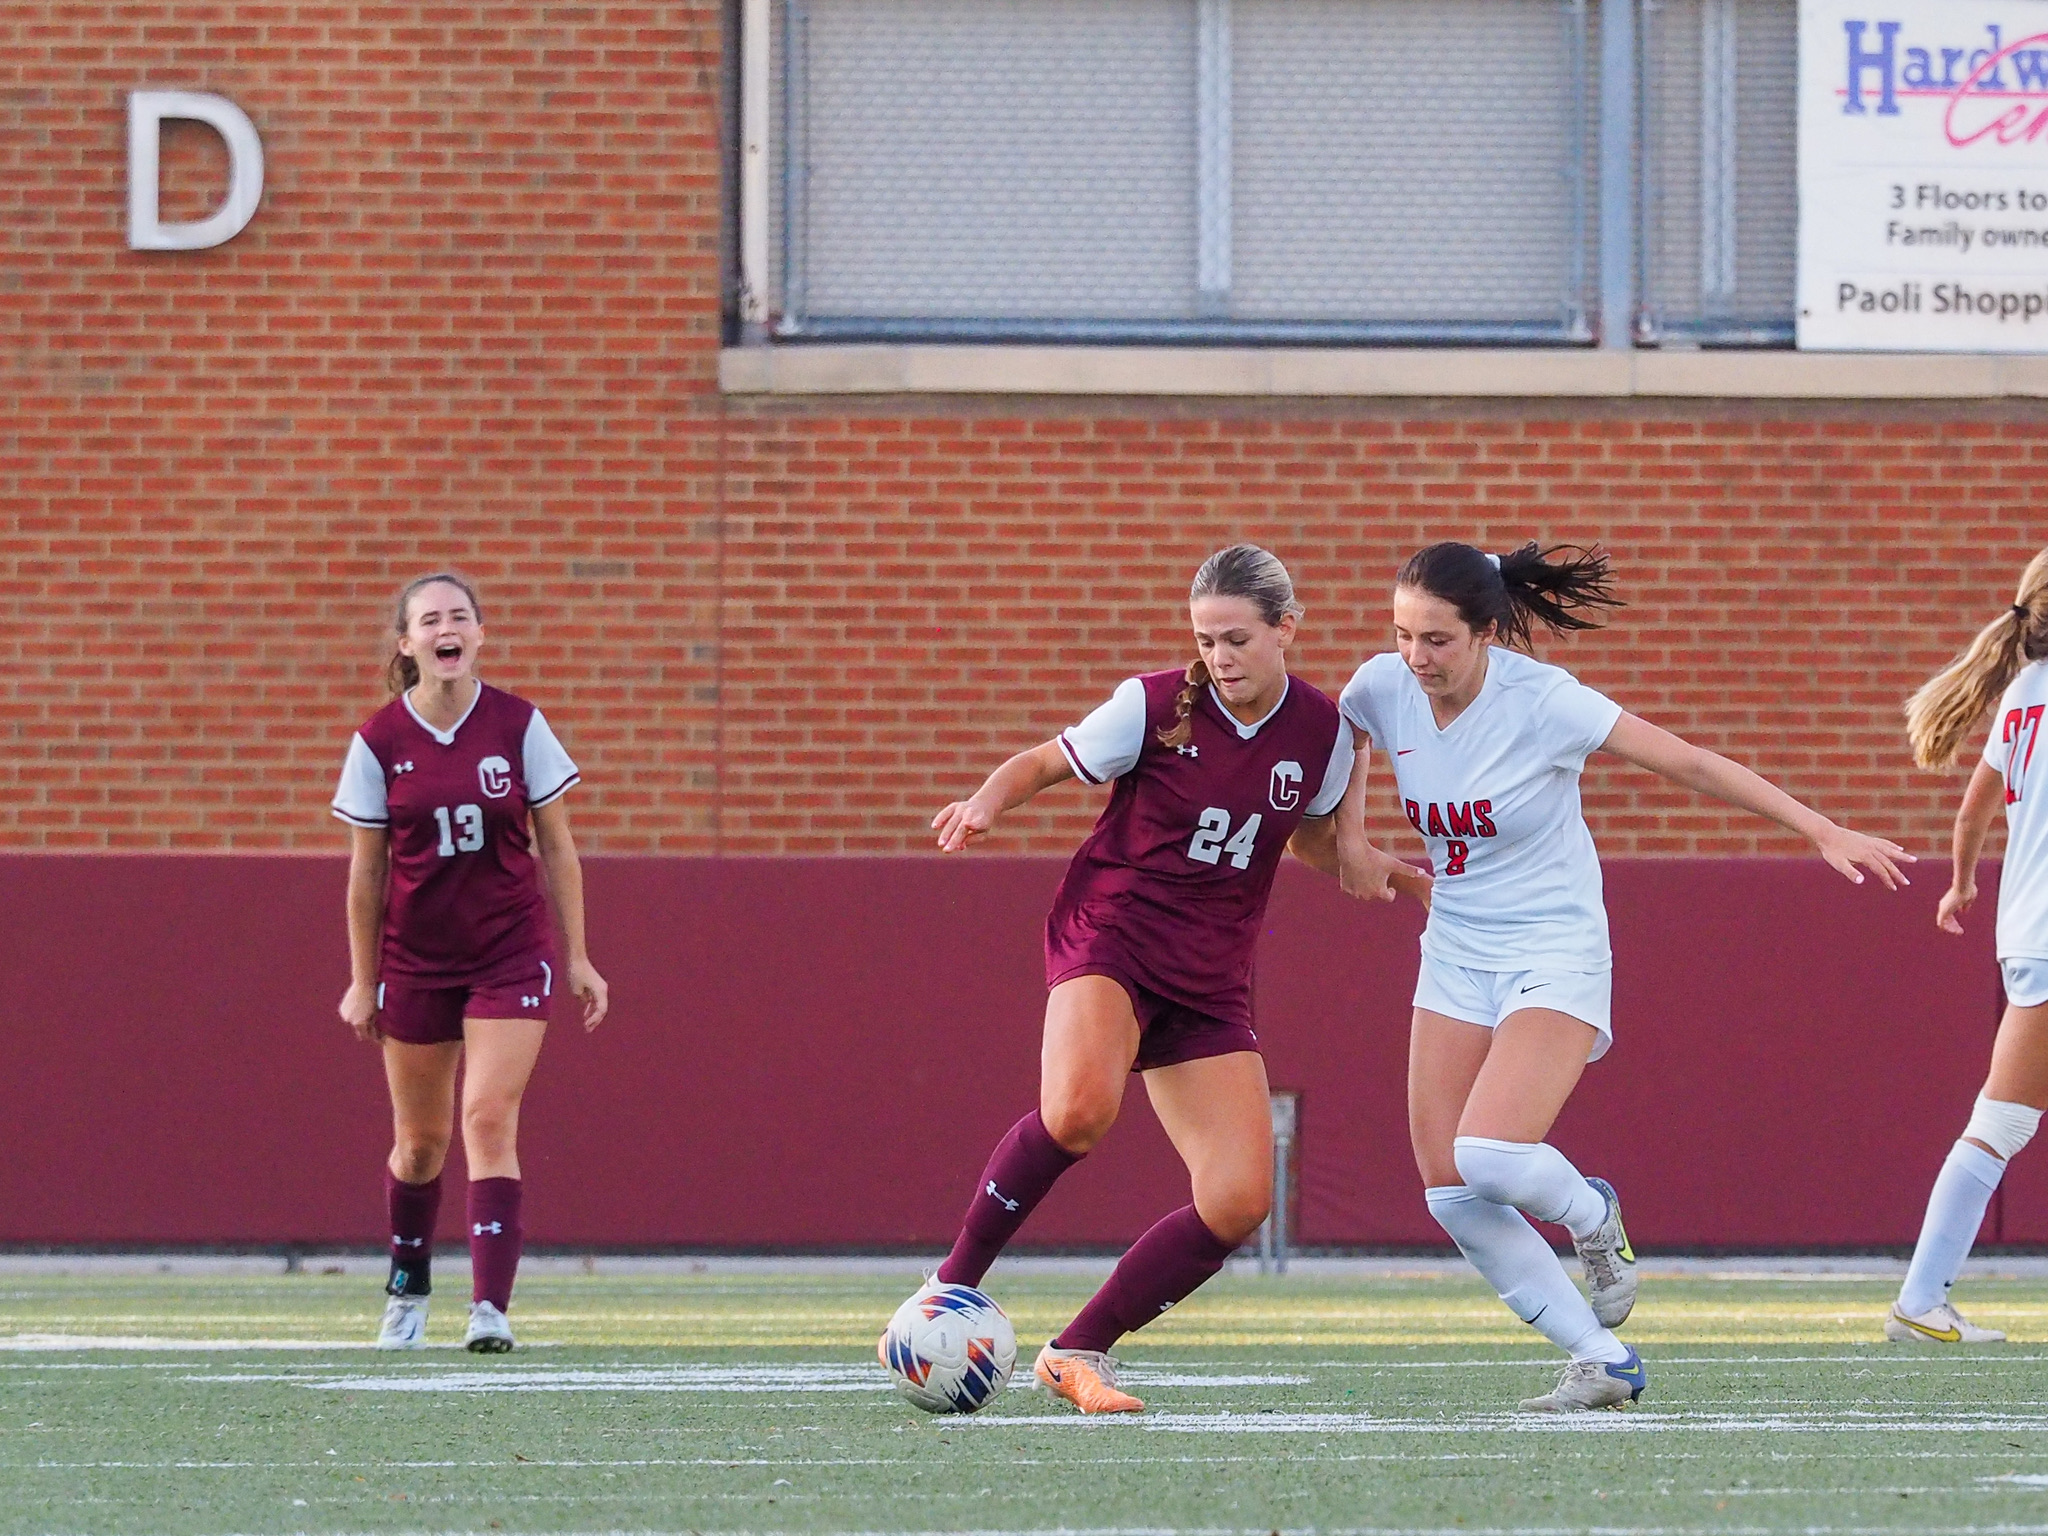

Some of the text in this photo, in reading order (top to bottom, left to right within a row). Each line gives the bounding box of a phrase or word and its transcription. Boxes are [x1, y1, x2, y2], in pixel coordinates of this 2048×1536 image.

[128, 91, 265, 250] D
[1892, 185, 2048, 211] 3 Floors to
[1888, 221, 1975, 253] Family
[1838, 283, 1921, 313] Paoli
[2003, 704, 2046, 805] 27
[433, 804, 484, 857] 13
[1187, 806, 1262, 870] 24
[1405, 798, 1498, 838] RAMS
[1445, 840, 1470, 876] 8
